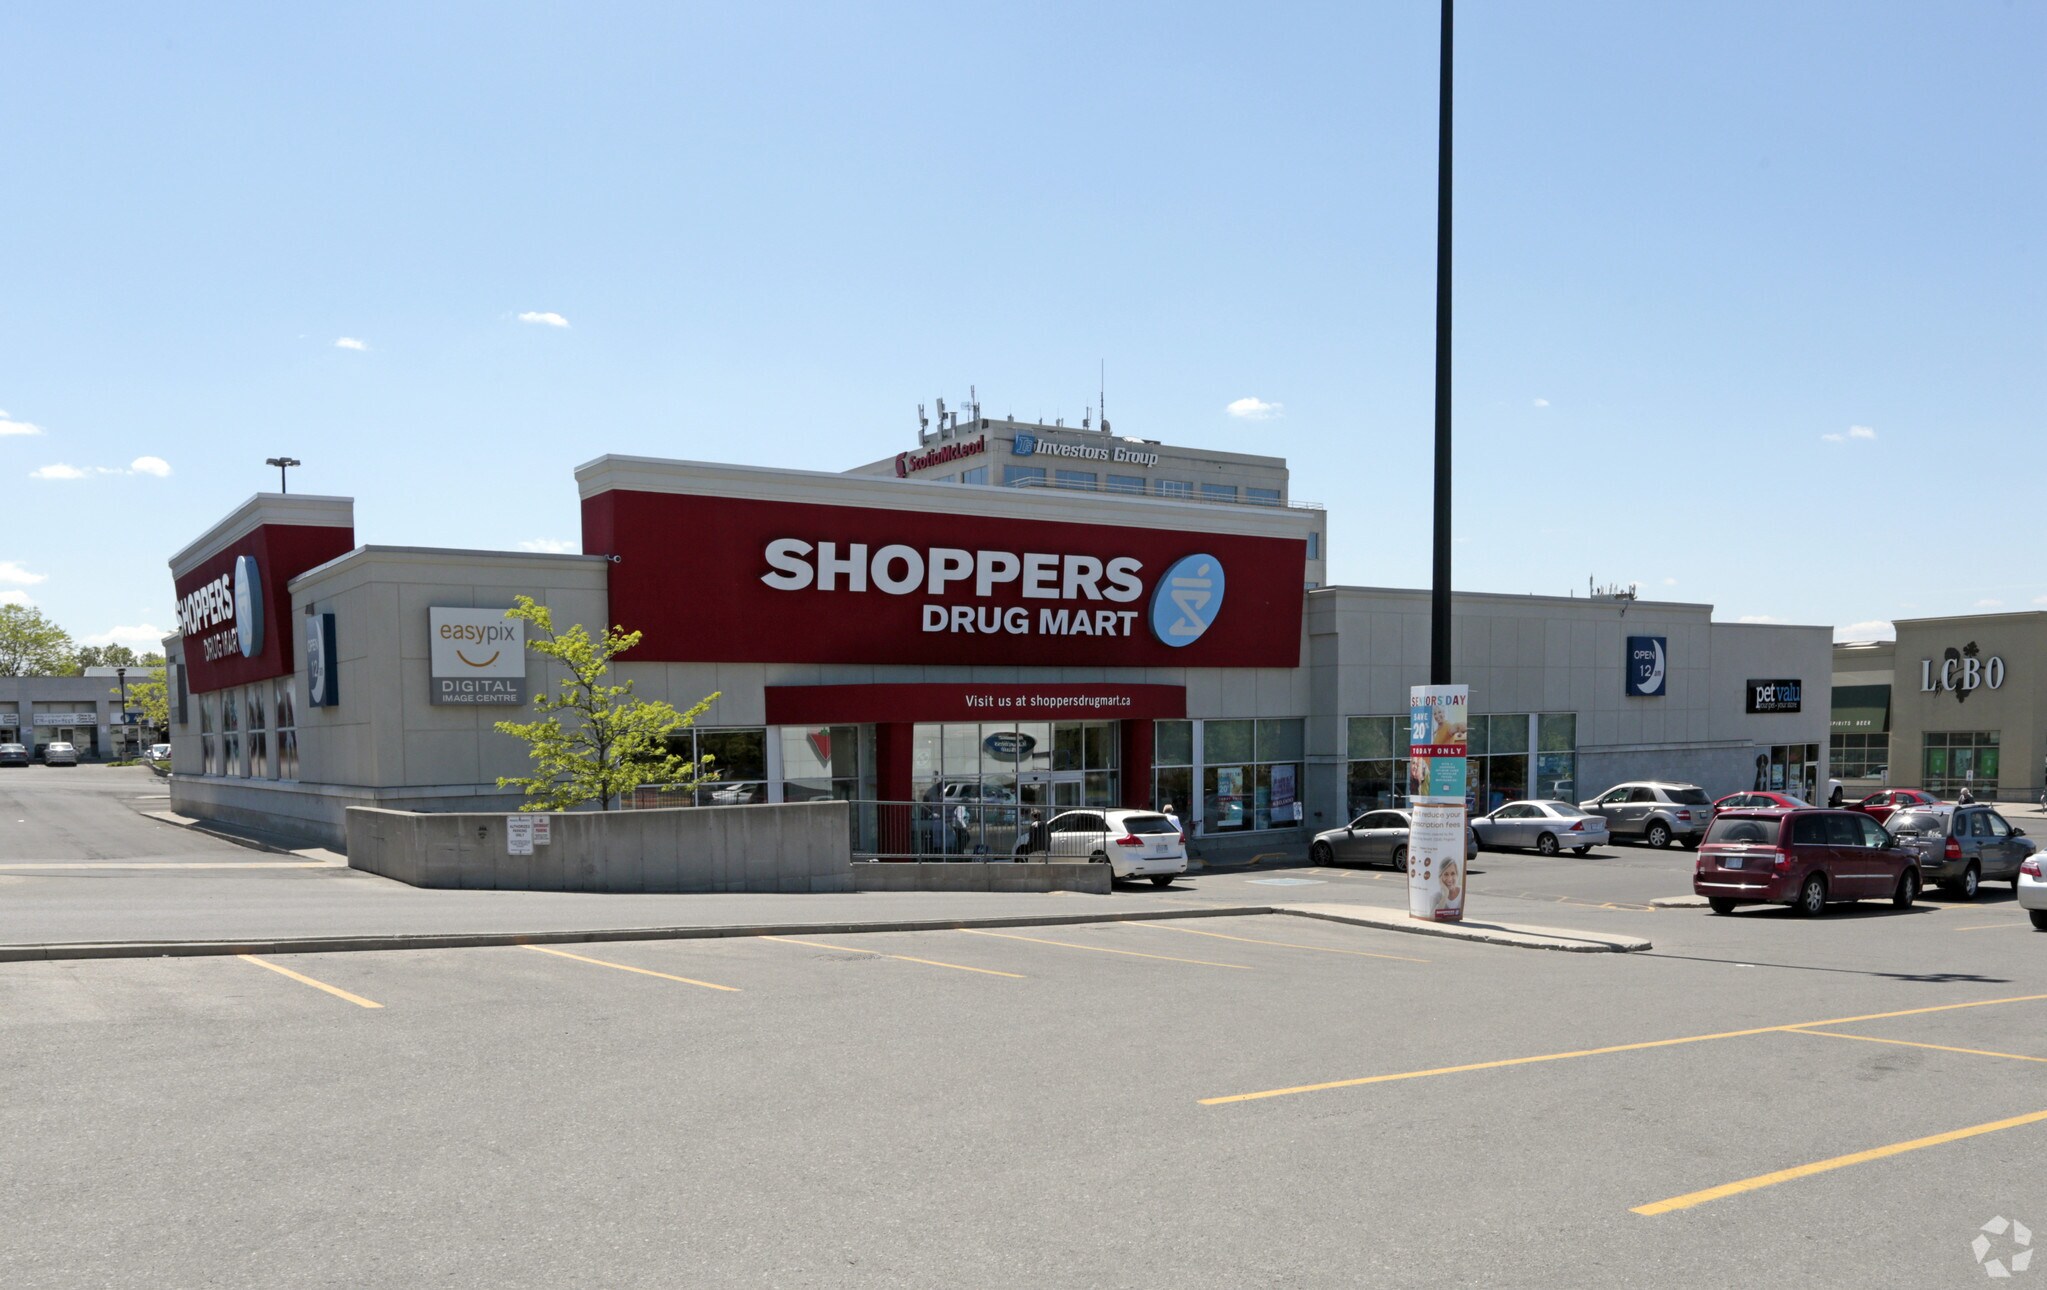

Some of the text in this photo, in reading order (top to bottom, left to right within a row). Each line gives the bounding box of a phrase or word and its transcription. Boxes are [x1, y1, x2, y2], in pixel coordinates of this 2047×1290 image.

[909, 435, 984, 472] ScotiaMcLeod
[1035, 439, 1159, 468] Investors Group
[760, 538, 1143, 602] SHOPPERS
[175, 573, 233, 639] SHOPPERS
[922, 605, 1138, 637] DRUG MART
[440, 621, 515, 645] easypix
[203, 633, 222, 662] DRUG
[1634, 650, 1655, 660] OPEN
[1640, 664, 1652, 677] 12
[1920, 656, 2005, 692] LCBO
[442, 680, 517, 692] DIGITAL
[442, 694, 517, 702] IMAGE CENTRE
[965, 695, 1131, 708] Visit us at shoppersdrugmart.ca
[1445, 695, 1466, 706] DAY
[1755, 682, 1800, 709] pet valu
[1413, 713, 1428, 721] SAVE
[1437, 747, 1462, 755] ONLY
[1446, 812, 1460, 820] your
